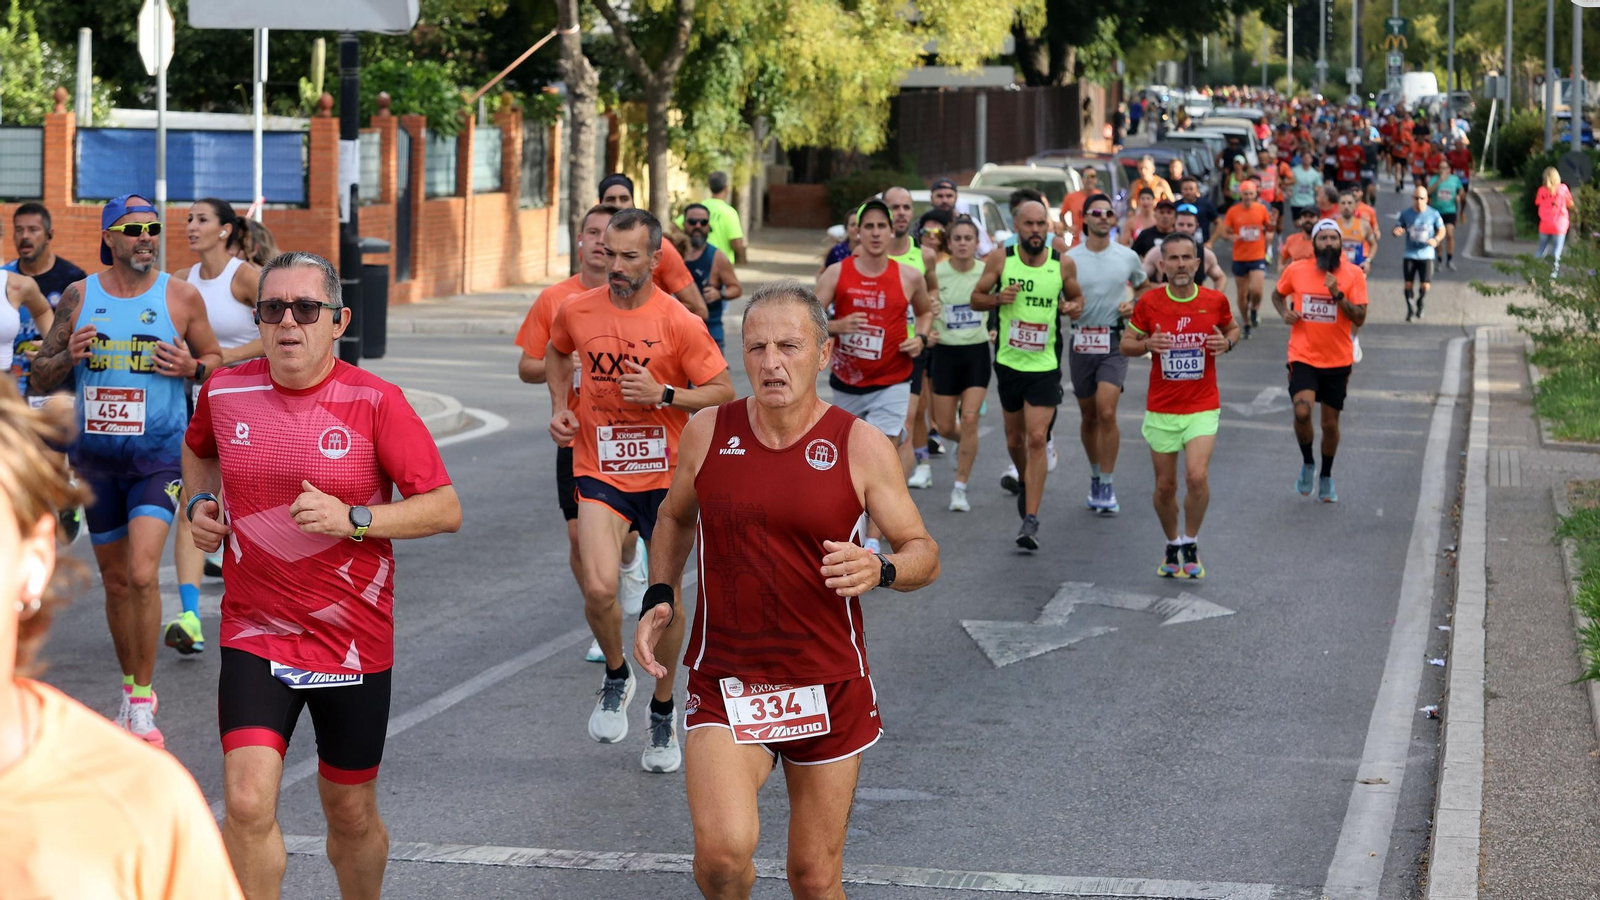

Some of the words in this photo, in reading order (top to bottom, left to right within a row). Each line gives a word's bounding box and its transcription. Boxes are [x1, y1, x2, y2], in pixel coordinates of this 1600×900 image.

[1008, 278, 1034, 292] PRO
[1025, 296, 1053, 308] TEAM
[1310, 305, 1328, 314] 460
[954, 312, 973, 321] 789
[849, 334, 869, 347] 461
[1018, 330, 1038, 342] 551
[1082, 335, 1100, 344] 314
[1168, 359, 1198, 370] 1068
[98, 403, 129, 419] 454
[615, 441, 650, 458] 305
[750, 692, 802, 721] 334
